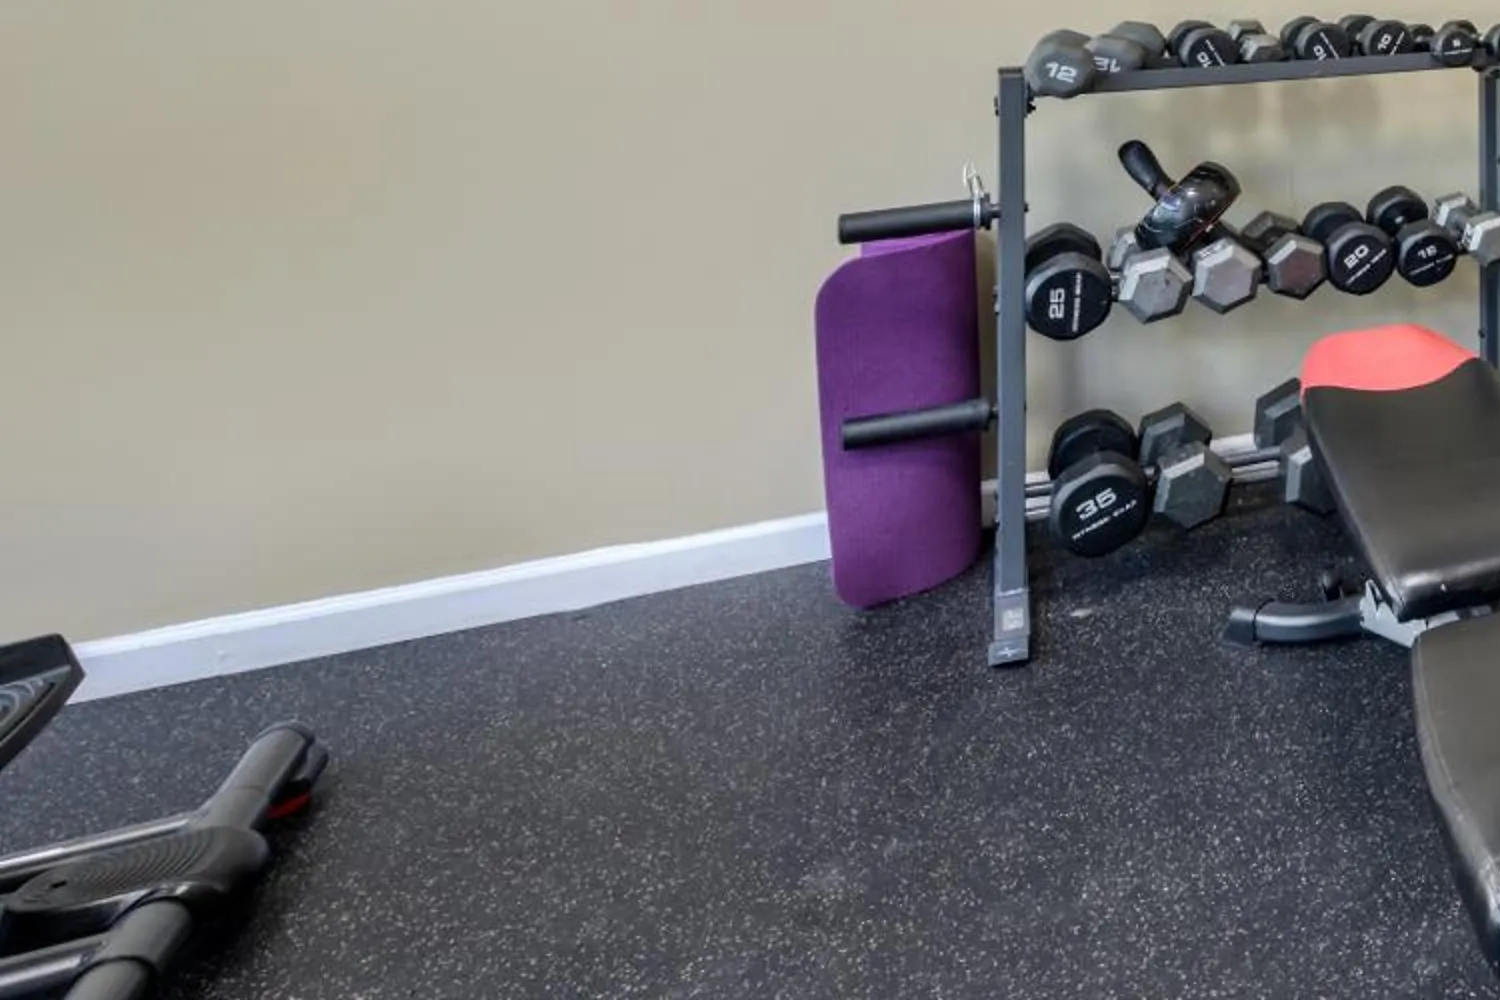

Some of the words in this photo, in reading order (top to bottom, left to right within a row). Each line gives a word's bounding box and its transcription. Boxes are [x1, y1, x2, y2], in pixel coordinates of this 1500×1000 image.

[1045, 61, 1077, 83] 12
[1343, 244, 1370, 269] 20
[1048, 287, 1066, 320] 25
[1075, 488, 1117, 520] 35
